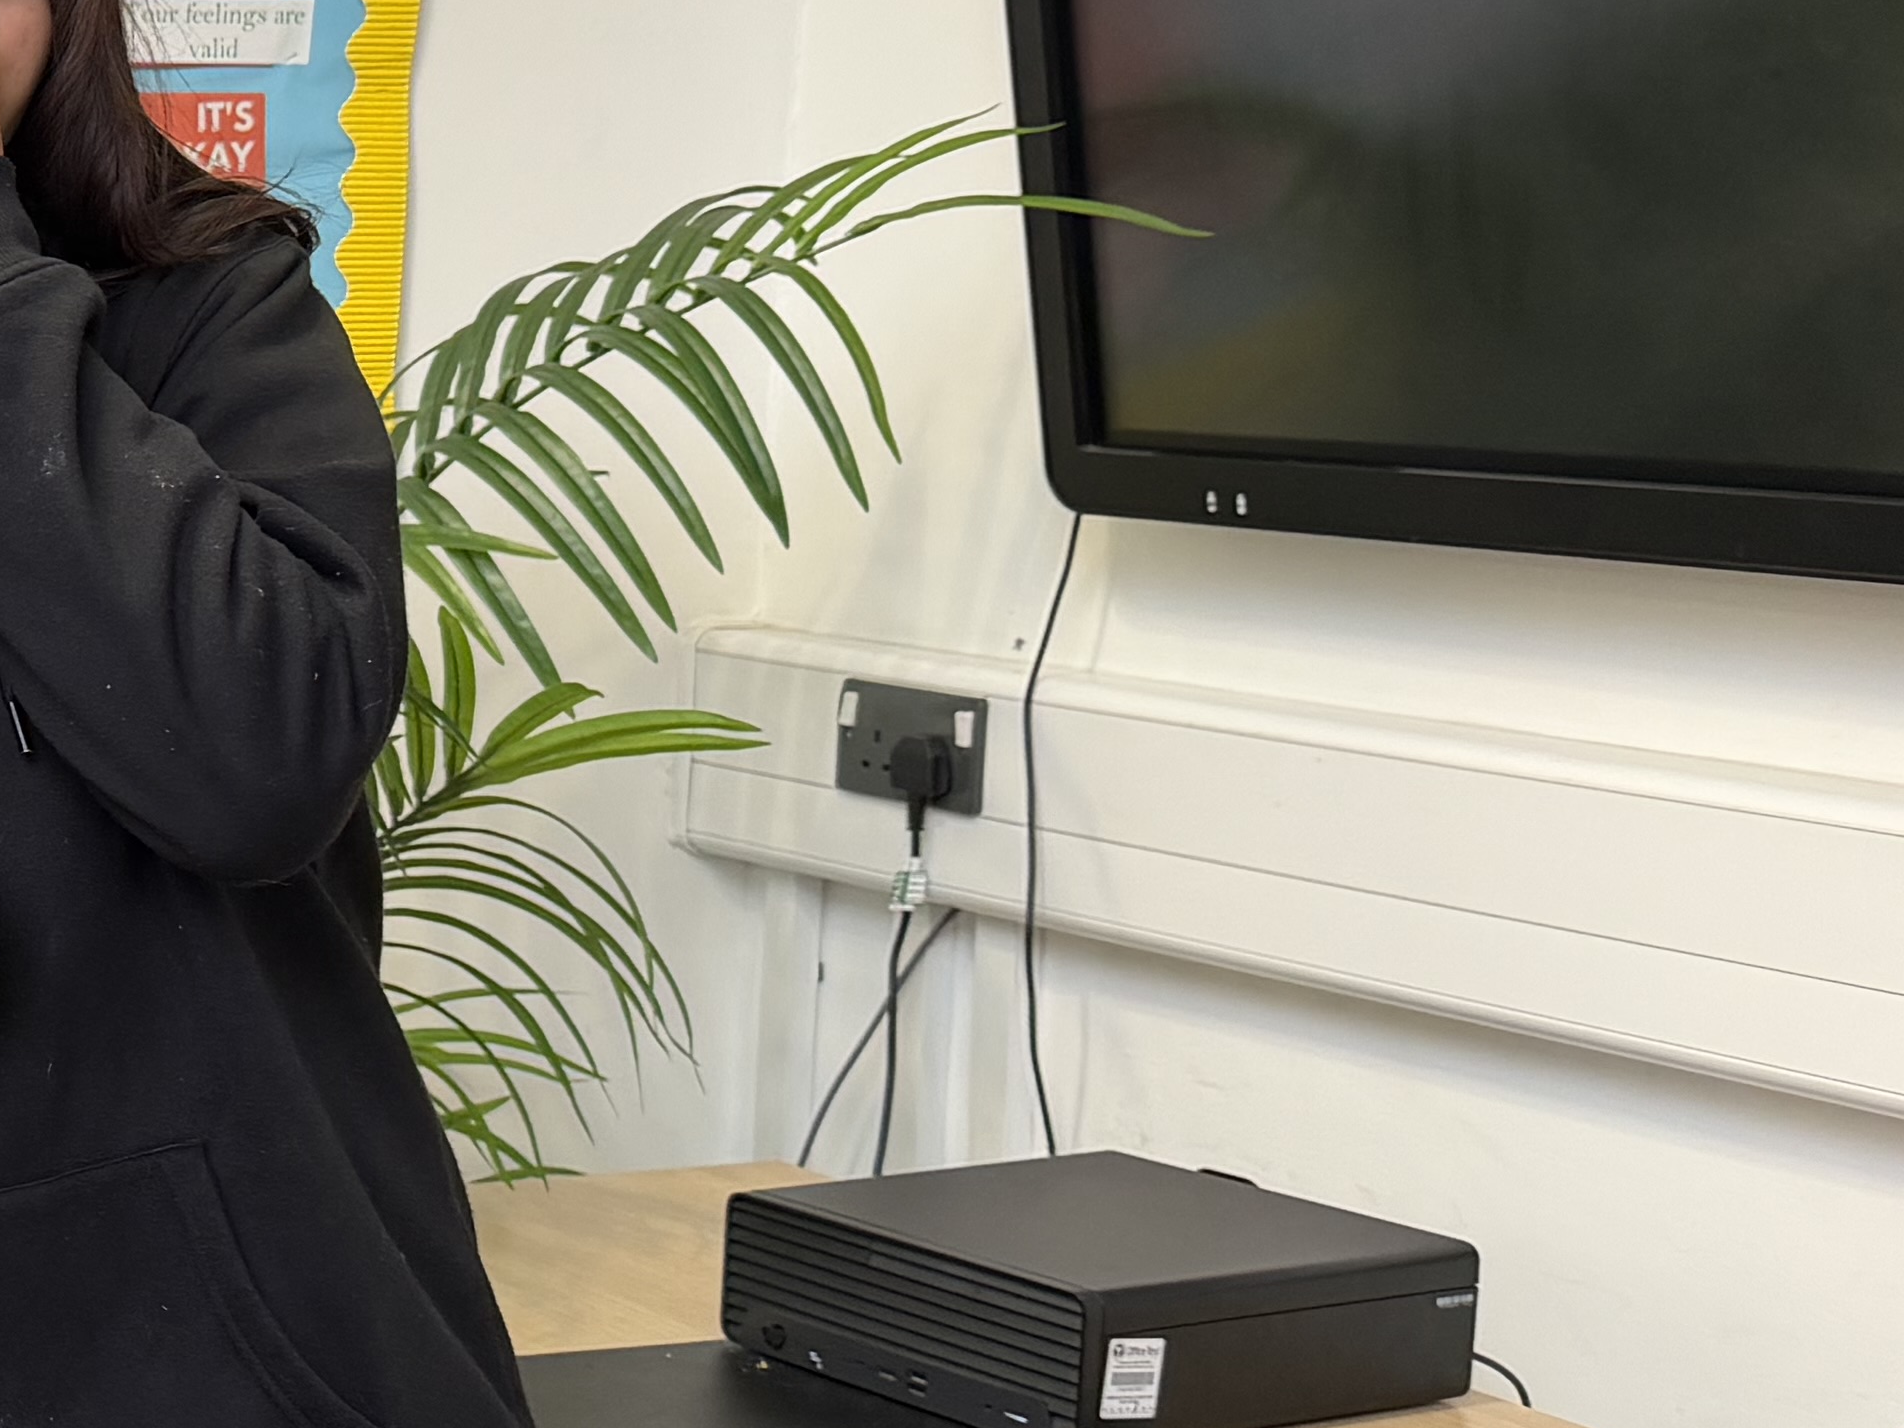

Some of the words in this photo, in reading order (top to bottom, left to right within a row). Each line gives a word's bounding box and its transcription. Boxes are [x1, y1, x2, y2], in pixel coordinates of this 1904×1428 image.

[185, 2, 267, 32] feelings
[274, 7, 306, 25] are
[189, 38, 238, 59] valid
[197, 101, 255, 133] IT'S
[184, 140, 255, 173] KAY
